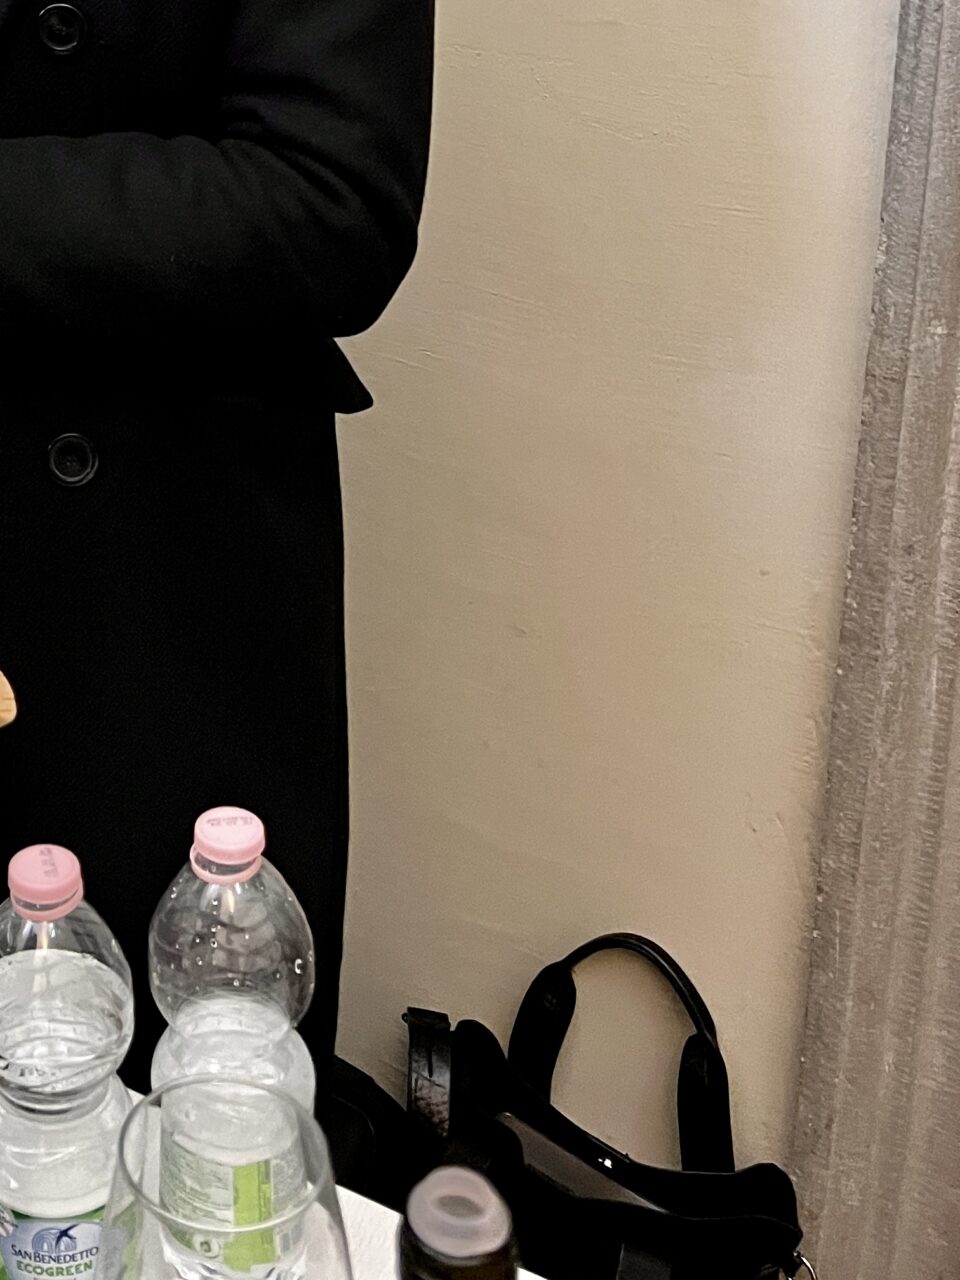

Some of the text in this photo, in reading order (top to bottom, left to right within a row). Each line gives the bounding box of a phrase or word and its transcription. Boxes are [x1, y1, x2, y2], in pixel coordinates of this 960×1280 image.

[11, 1243, 100, 1265] SAN BENEDETTO
[15, 1260, 94, 1277] ECOGREEN
